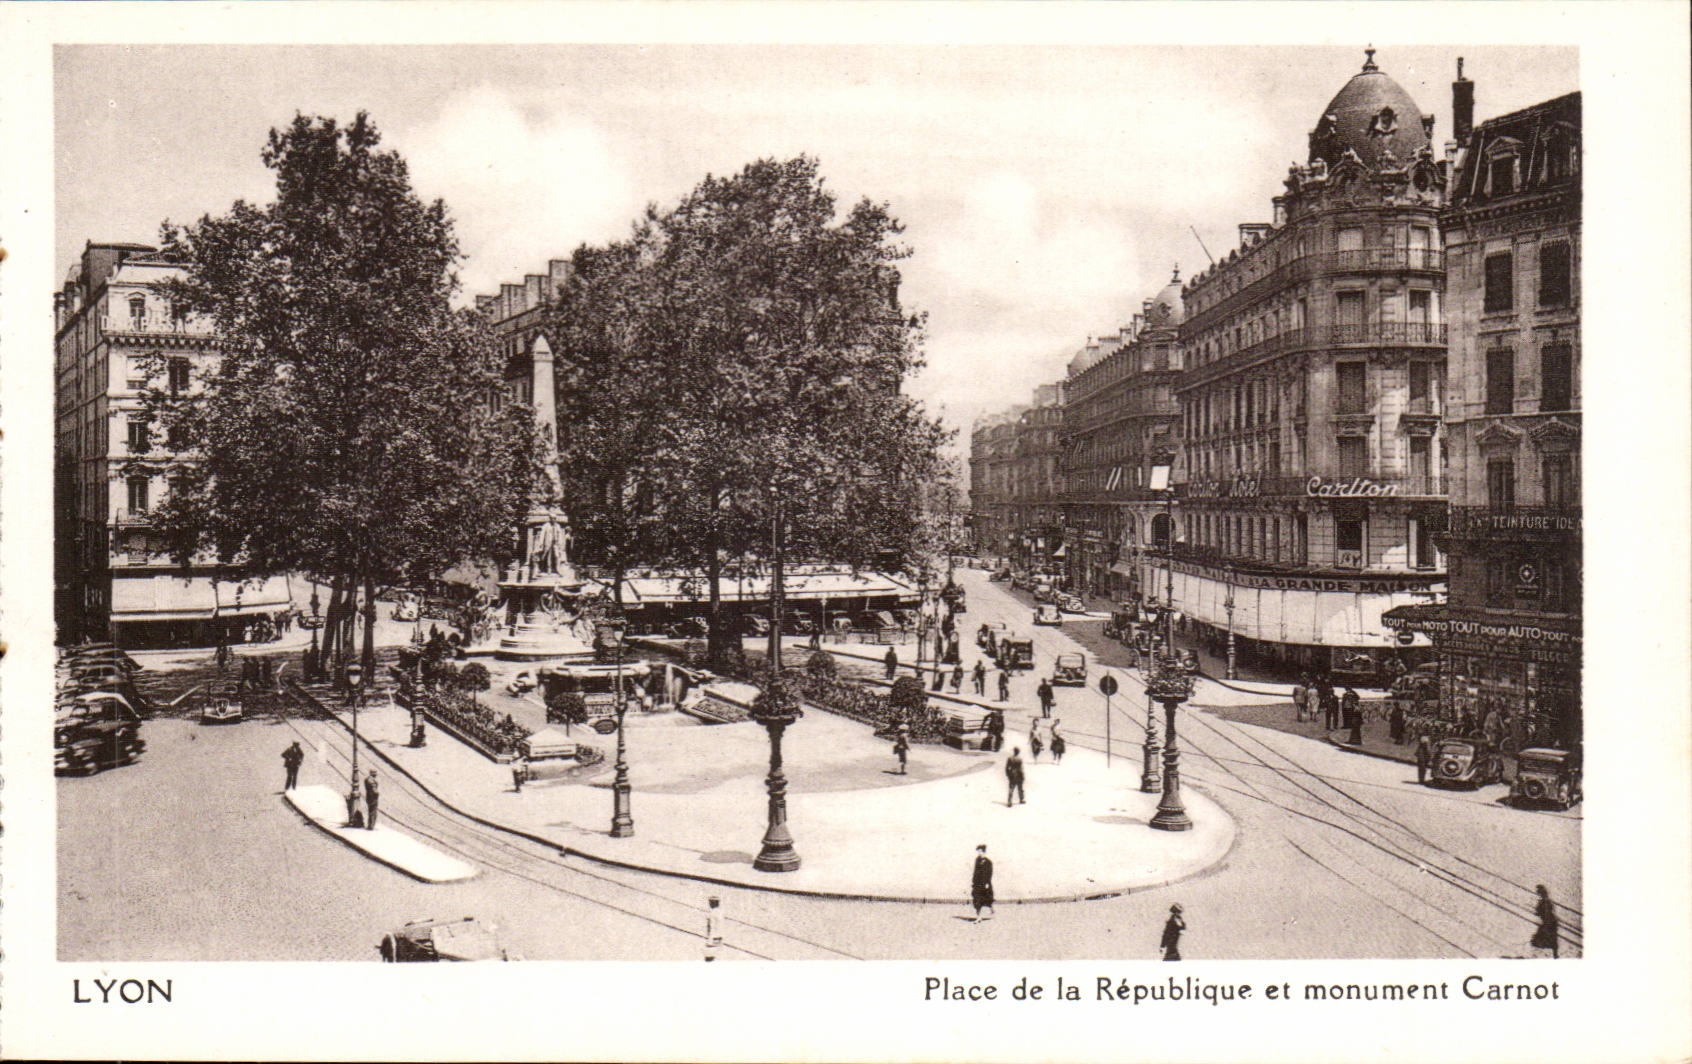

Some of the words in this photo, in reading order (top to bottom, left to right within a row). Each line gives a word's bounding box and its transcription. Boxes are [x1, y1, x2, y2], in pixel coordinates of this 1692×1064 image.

[1306, 476, 1398, 497] Carlton
[1275, 579, 1352, 592] GRANDE
[1382, 617, 1406, 628] TOUT
[1422, 620, 1449, 632] MOTO
[1449, 620, 1480, 635] TOUT
[1480, 626, 1506, 637] POUR
[1508, 625, 1541, 640] AUTO
[1543, 631, 1569, 642] TOUT
